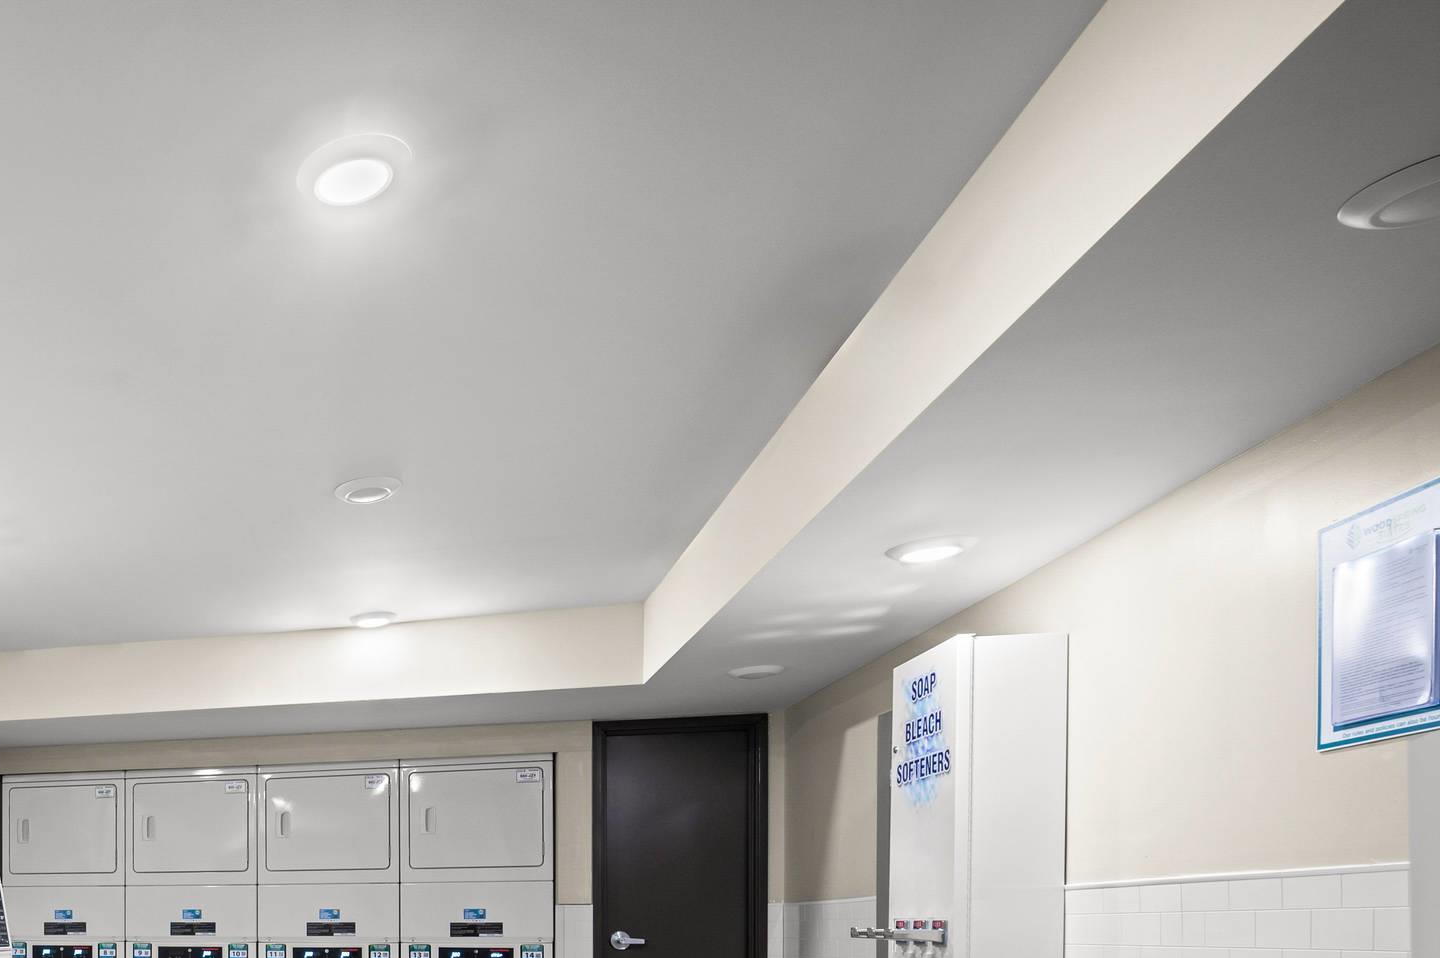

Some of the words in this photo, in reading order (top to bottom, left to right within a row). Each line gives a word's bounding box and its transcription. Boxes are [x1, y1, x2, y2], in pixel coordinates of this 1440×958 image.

[911, 672, 936, 701] SOAP
[905, 710, 942, 743] BLEACH
[897, 749, 950, 784] SOFTENERS
